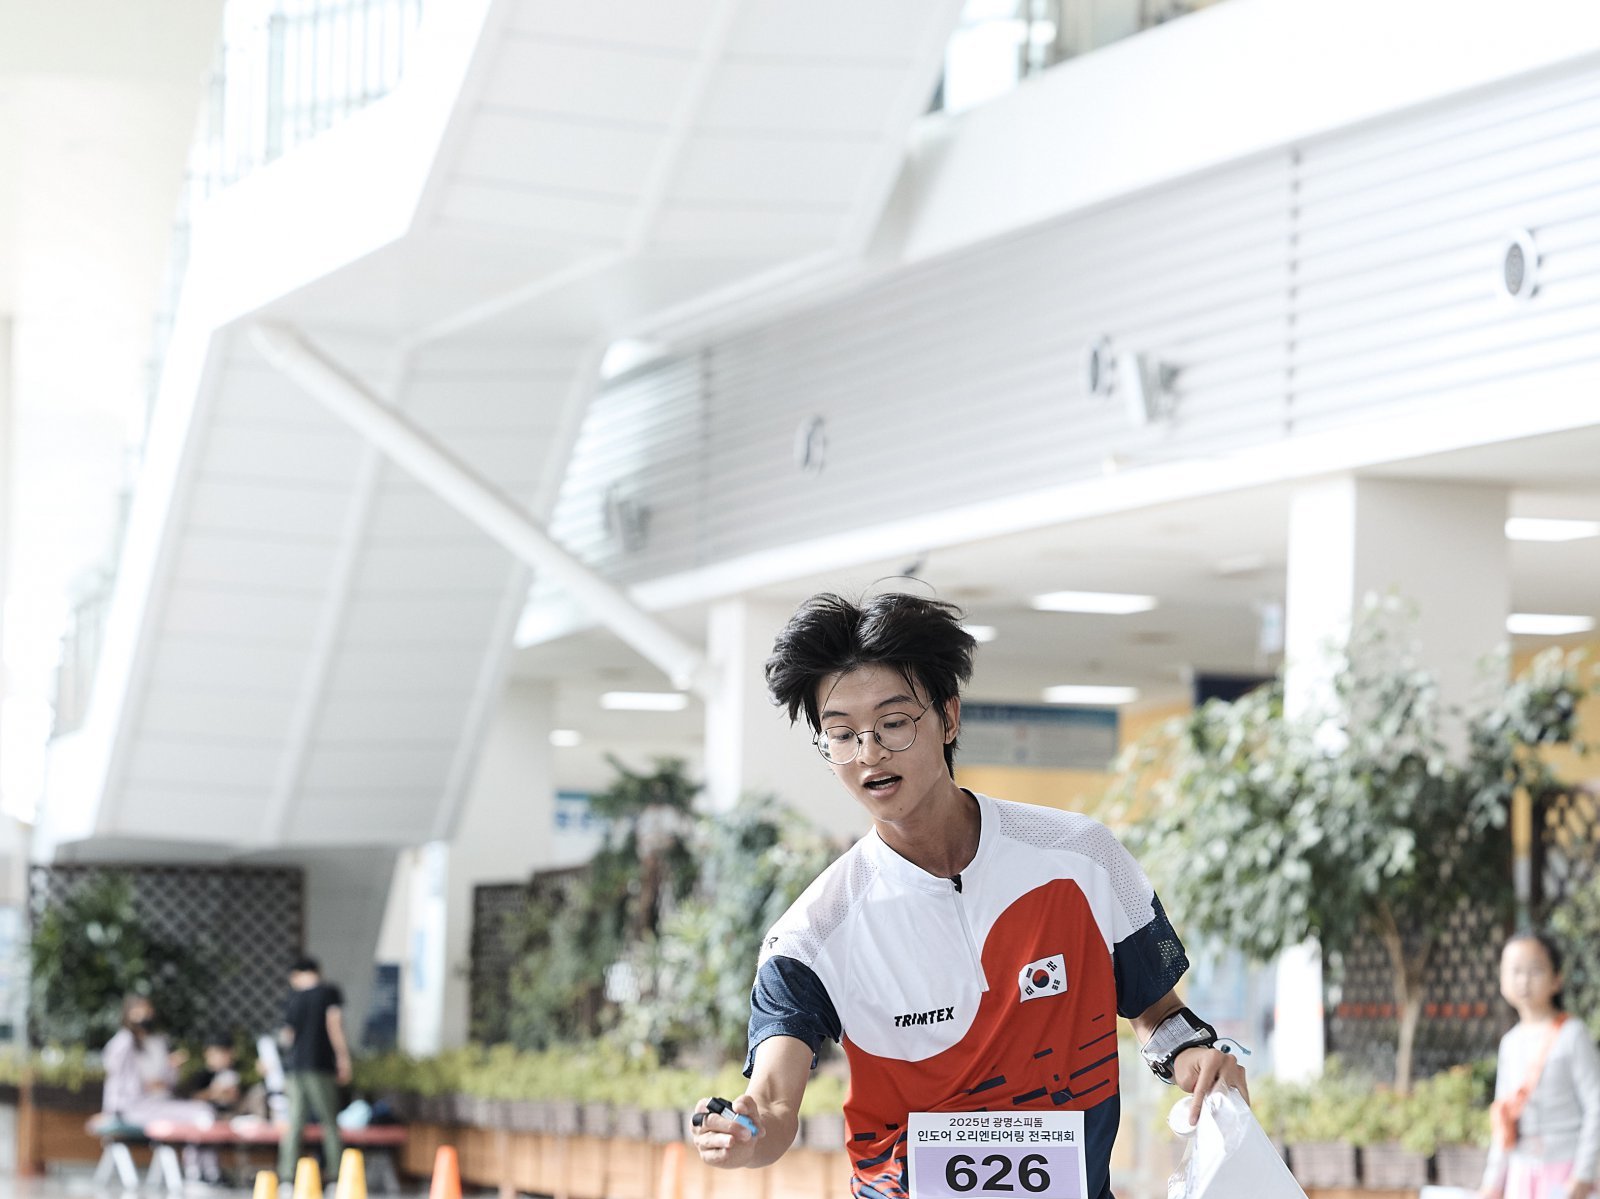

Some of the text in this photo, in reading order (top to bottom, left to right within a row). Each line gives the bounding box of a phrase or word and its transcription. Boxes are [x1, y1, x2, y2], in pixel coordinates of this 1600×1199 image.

[894, 1006, 955, 1028] TRIMTEX
[949, 1117, 1044, 1128] 2025년 광명스피돔
[917, 1130, 1075, 1143] 인도어 오리엔티어링 전국대회
[945, 1153, 1051, 1193] 626
